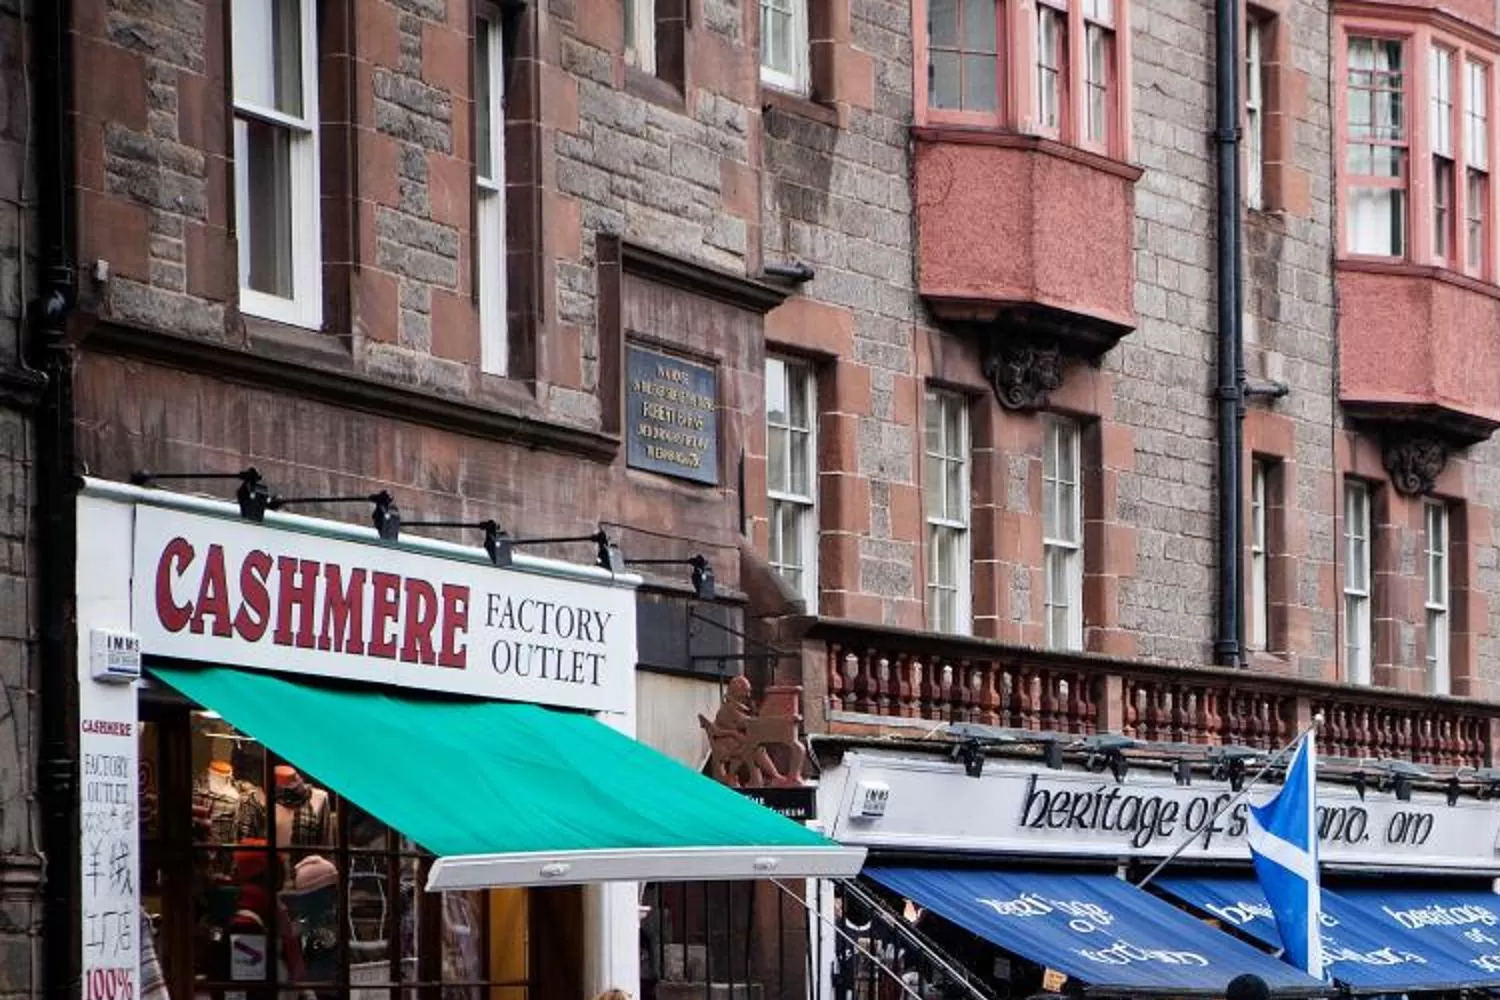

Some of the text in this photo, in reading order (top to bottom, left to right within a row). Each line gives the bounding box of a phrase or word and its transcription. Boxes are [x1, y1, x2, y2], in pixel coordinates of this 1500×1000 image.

[155, 536, 470, 670] CASHMERE
[484, 592, 616, 643] FACTORY
[491, 640, 606, 687] OUTLET
[82, 719, 132, 737] CASHMERE
[85, 753, 130, 778] FACTORY
[87, 782, 129, 804] OUTLET
[1020, 774, 1179, 848] heritage
[1186, 793, 1231, 850] of
